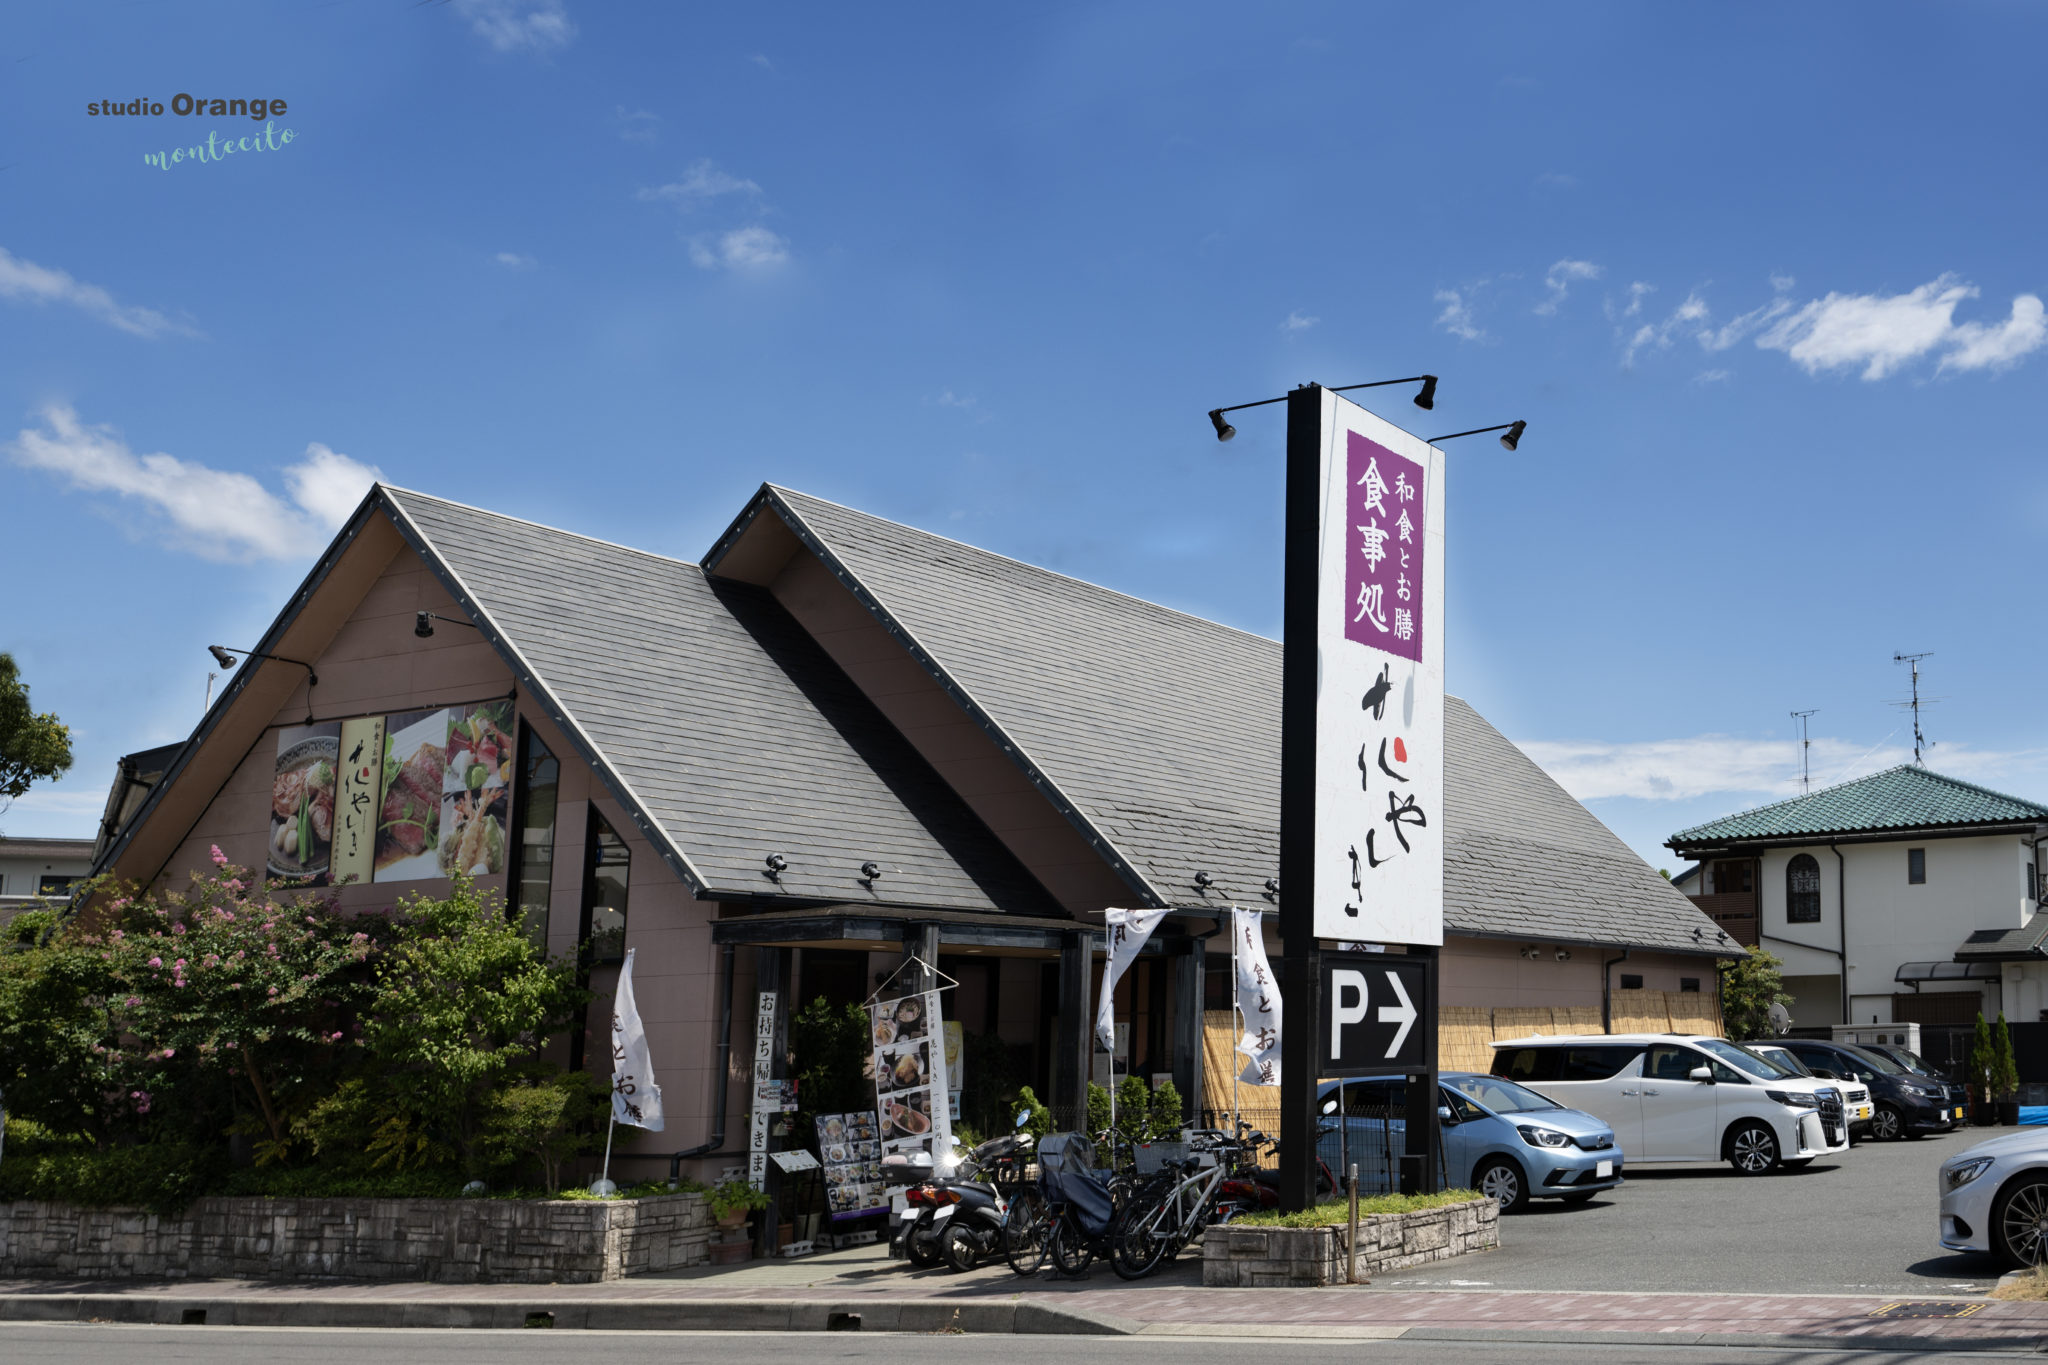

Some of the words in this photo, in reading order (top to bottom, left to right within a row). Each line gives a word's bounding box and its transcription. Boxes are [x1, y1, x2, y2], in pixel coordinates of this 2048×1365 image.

[1353, 457, 1390, 633] 食事処
[1394, 472, 1415, 641] 和食とお膳
[1330, 968, 1369, 1060] P
